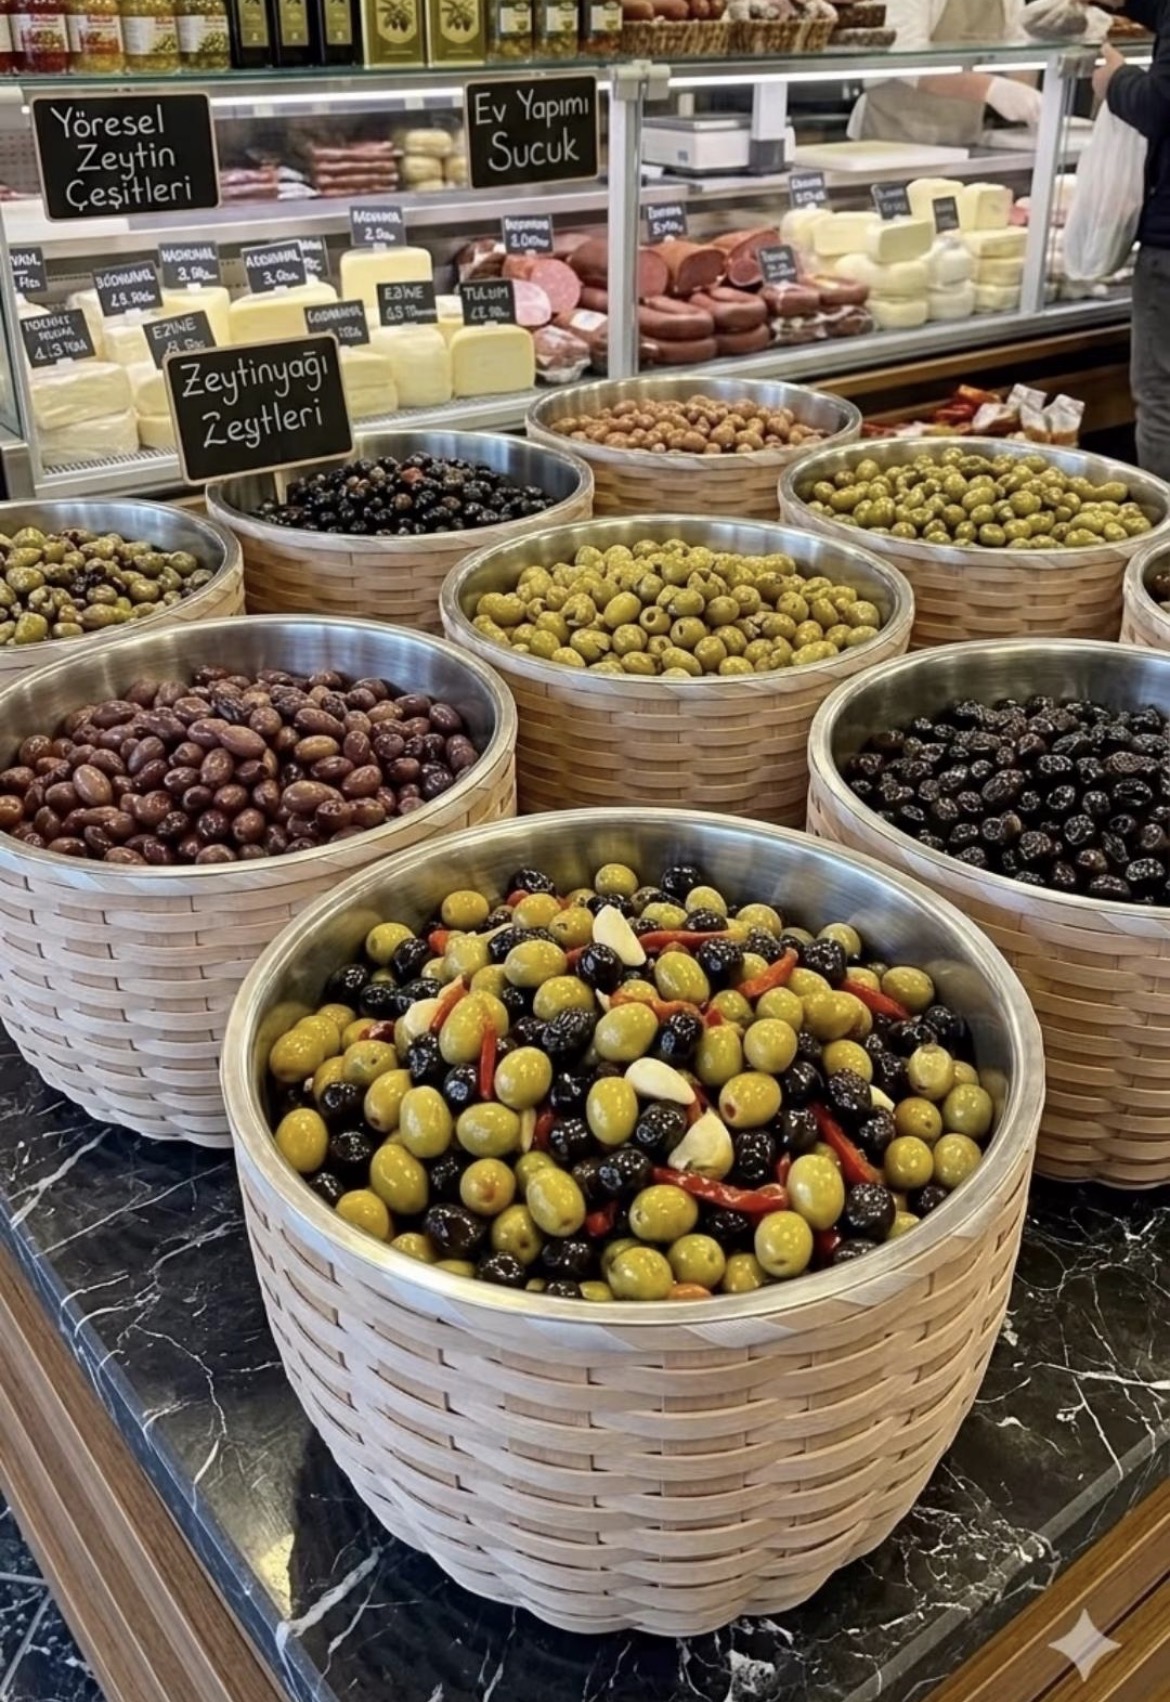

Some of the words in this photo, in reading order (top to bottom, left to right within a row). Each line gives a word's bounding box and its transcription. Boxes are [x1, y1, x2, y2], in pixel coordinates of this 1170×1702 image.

[50, 103, 165, 138] Yöresel
[475, 92, 507, 125] Ev
[516, 88, 589, 128] Yapımı
[76, 142, 176, 181] Zeytin
[488, 126, 580, 171] Sucuk
[66, 175, 192, 211] Çeşitleri
[180, 351, 329, 406] Zeytinyağı
[202, 398, 323, 448] Zeytleri
